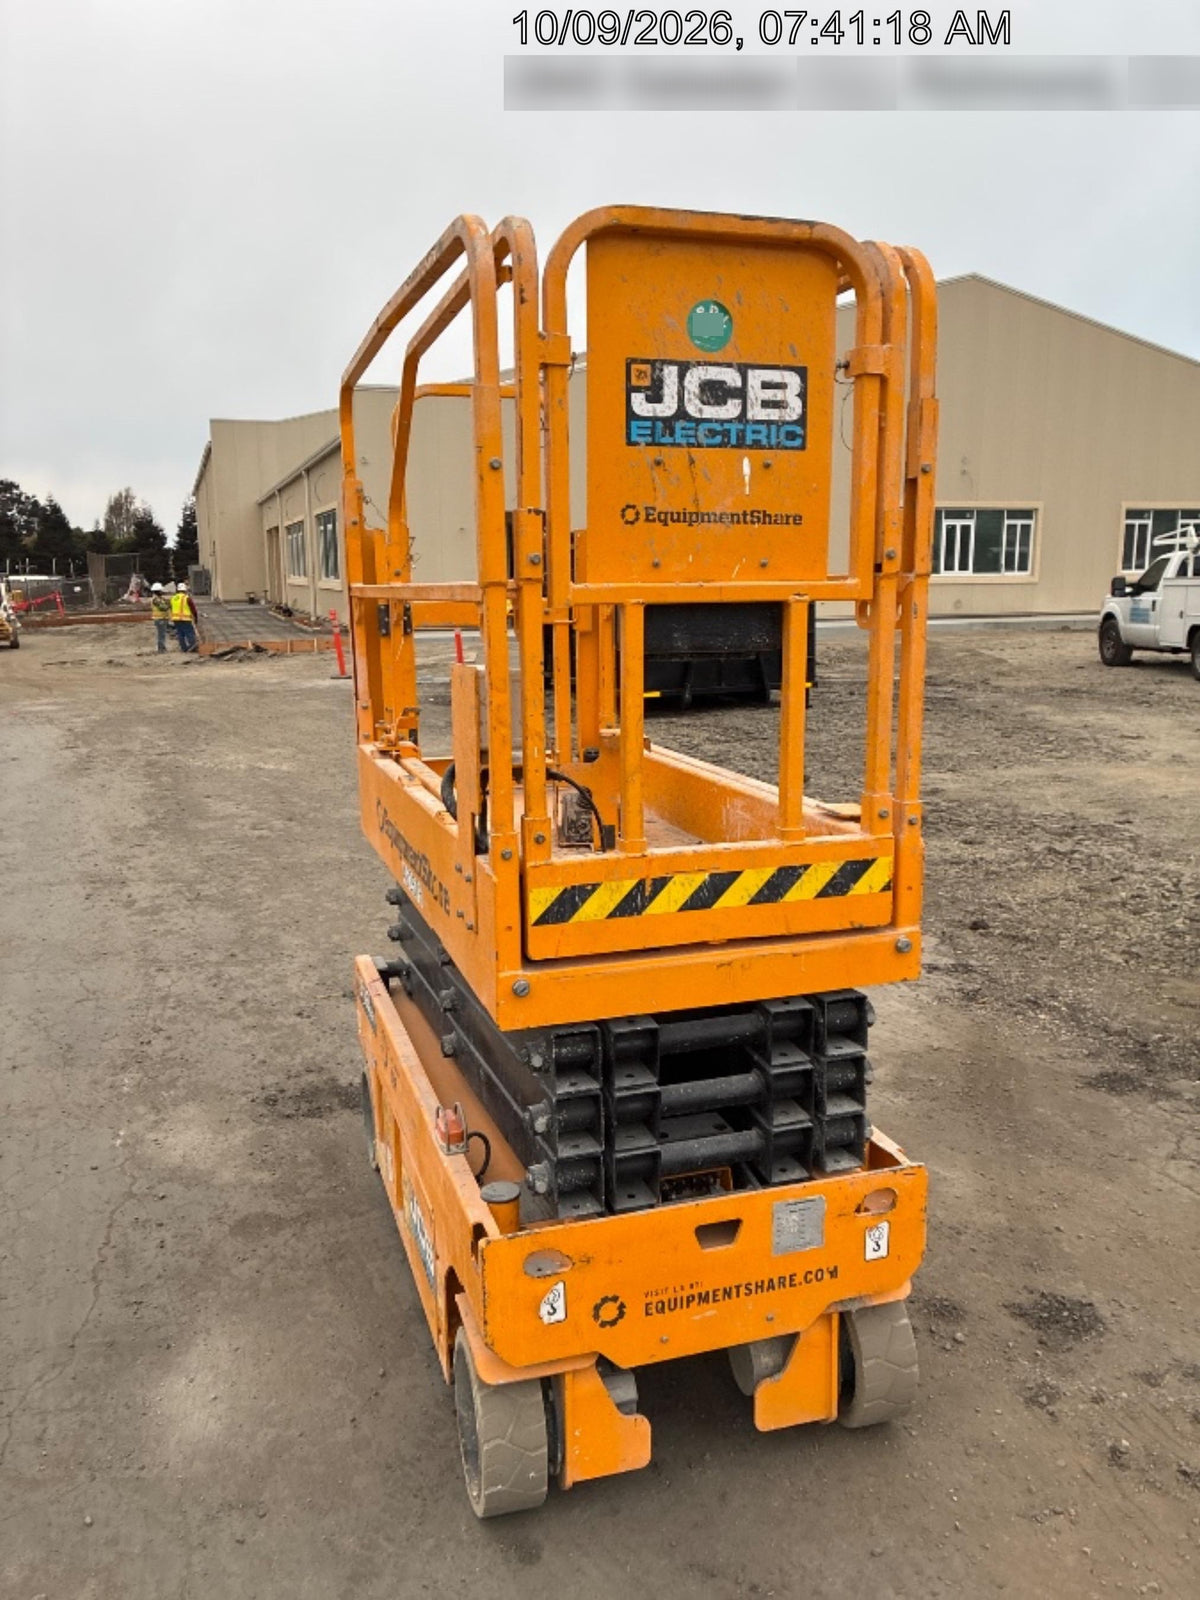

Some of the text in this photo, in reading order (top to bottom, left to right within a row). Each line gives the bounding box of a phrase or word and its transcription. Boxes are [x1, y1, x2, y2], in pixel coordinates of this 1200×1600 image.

[630, 364, 803, 421] JCB
[630, 420, 803, 447] ELECTRIC
[643, 506, 803, 527] EquipmentShare
[644, 1264, 839, 1317] EQUIPMENTSHARE.COM
